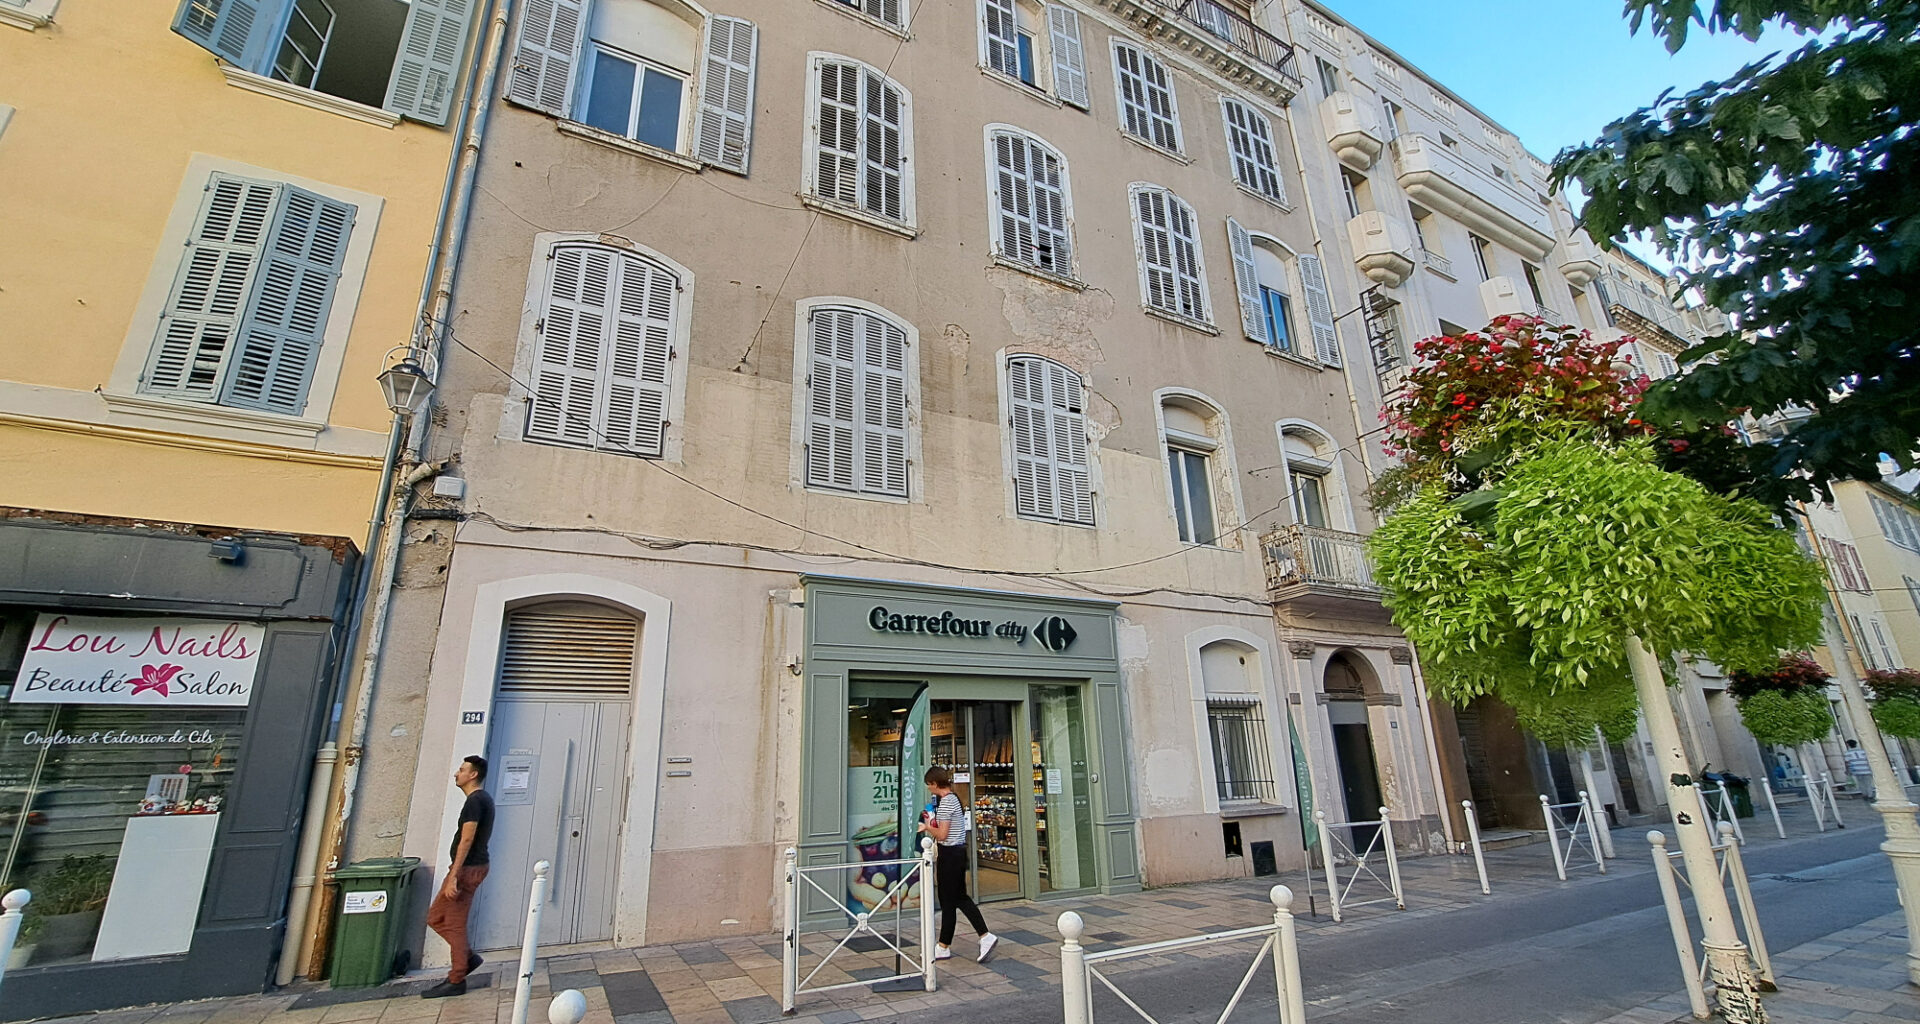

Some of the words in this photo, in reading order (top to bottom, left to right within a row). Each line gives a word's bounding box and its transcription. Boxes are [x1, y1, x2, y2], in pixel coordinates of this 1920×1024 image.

[869, 606, 991, 637] Carrefour
[995, 620, 1028, 644] city
[31, 616, 126, 654] Lou
[129, 622, 257, 659] Nails
[25, 667, 128, 693] Beauté
[169, 670, 248, 695] Salon
[465, 713, 481, 723] 294
[23, 729, 86, 750] Onglerie
[88, 731, 98, 743] &
[102, 730, 166, 745] Extension
[168, 730, 185, 744] de
[188, 729, 215, 744] Cils
[873, 770, 892, 783] 7h
[872, 784, 899, 799] 21h
